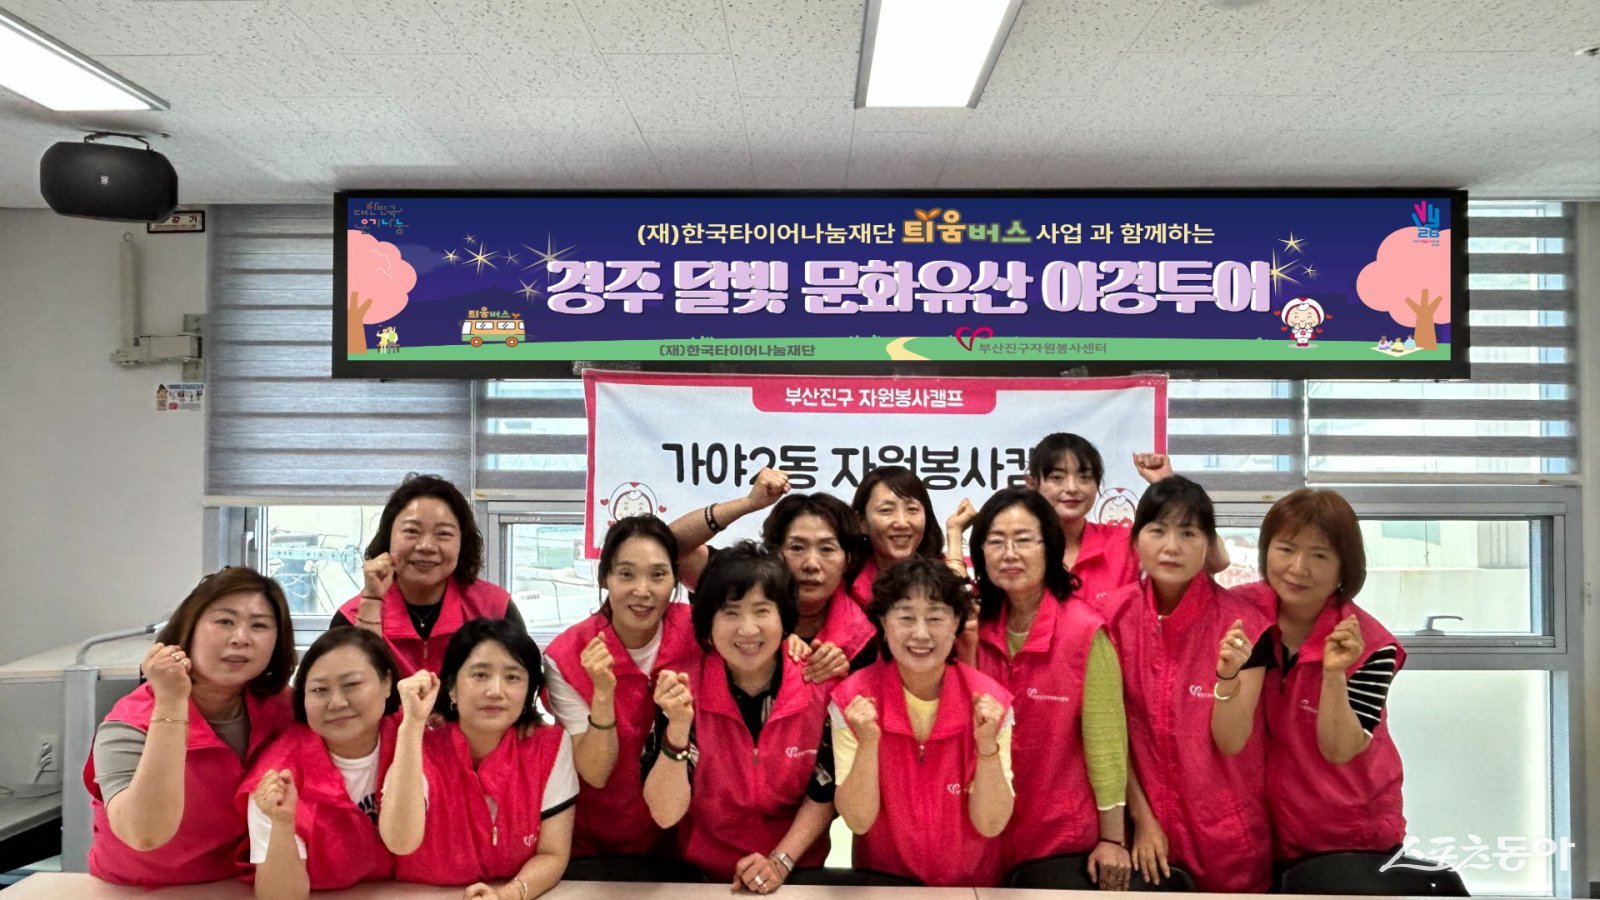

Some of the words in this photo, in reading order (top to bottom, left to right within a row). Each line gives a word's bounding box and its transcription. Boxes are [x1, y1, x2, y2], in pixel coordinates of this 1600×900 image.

[637, 223, 896, 246] (재)한국타이어나눔재단
[902, 209, 1033, 243] 틔움버스
[1036, 222, 1082, 244] 사업
[1090, 223, 1114, 244] 과
[1120, 222, 1216, 244] 함께하는
[547, 260, 664, 315] 경주
[673, 260, 789, 315] 달빛
[801, 259, 1034, 315] 문화유산
[1041, 260, 1272, 315] 야경투어
[659, 344, 816, 357] (재)한국타이어나눔재단
[978, 342, 1108, 355] 부산진구자원봉사센터
[784, 387, 855, 408] 부산진구
[858, 388, 965, 409] 자원봉사캠프
[661, 442, 819, 490] 가야2동
